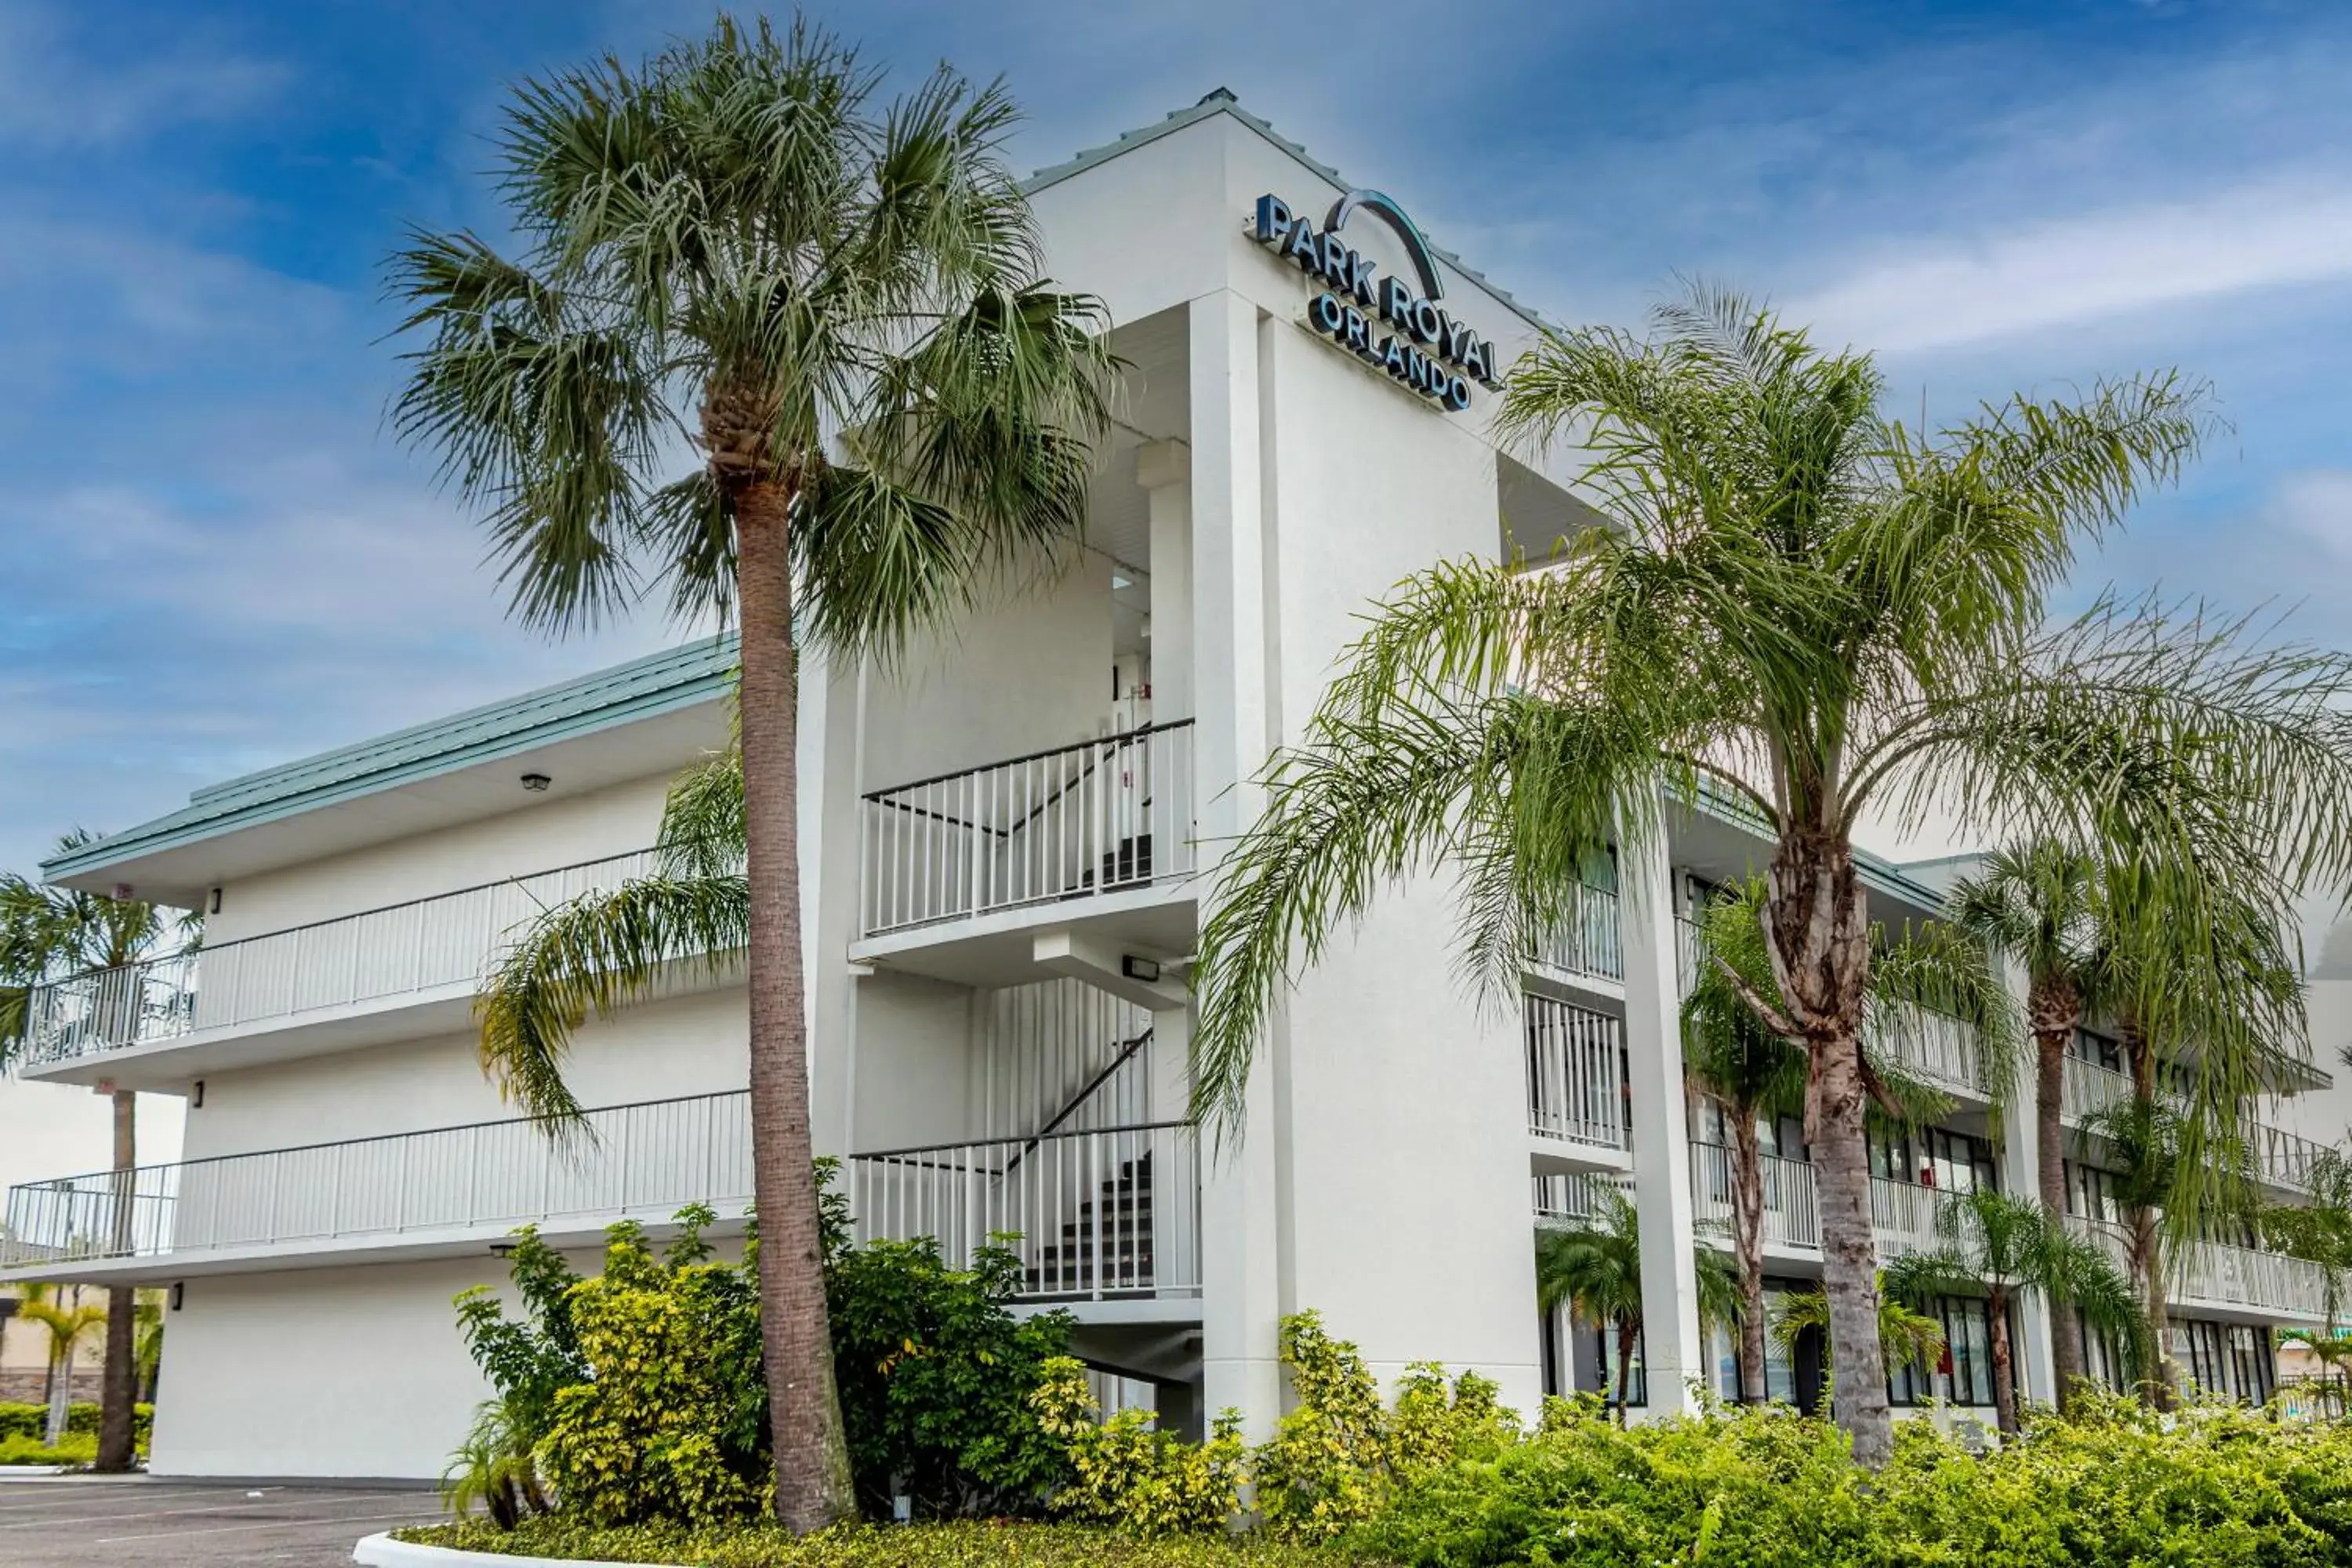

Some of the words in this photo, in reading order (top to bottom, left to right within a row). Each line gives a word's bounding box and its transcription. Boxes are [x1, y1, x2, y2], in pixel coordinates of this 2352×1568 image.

[1257, 194, 1377, 307] PARK
[1379, 276, 1507, 391] ROYAL
[1308, 292, 1471, 412] ORLANDO
